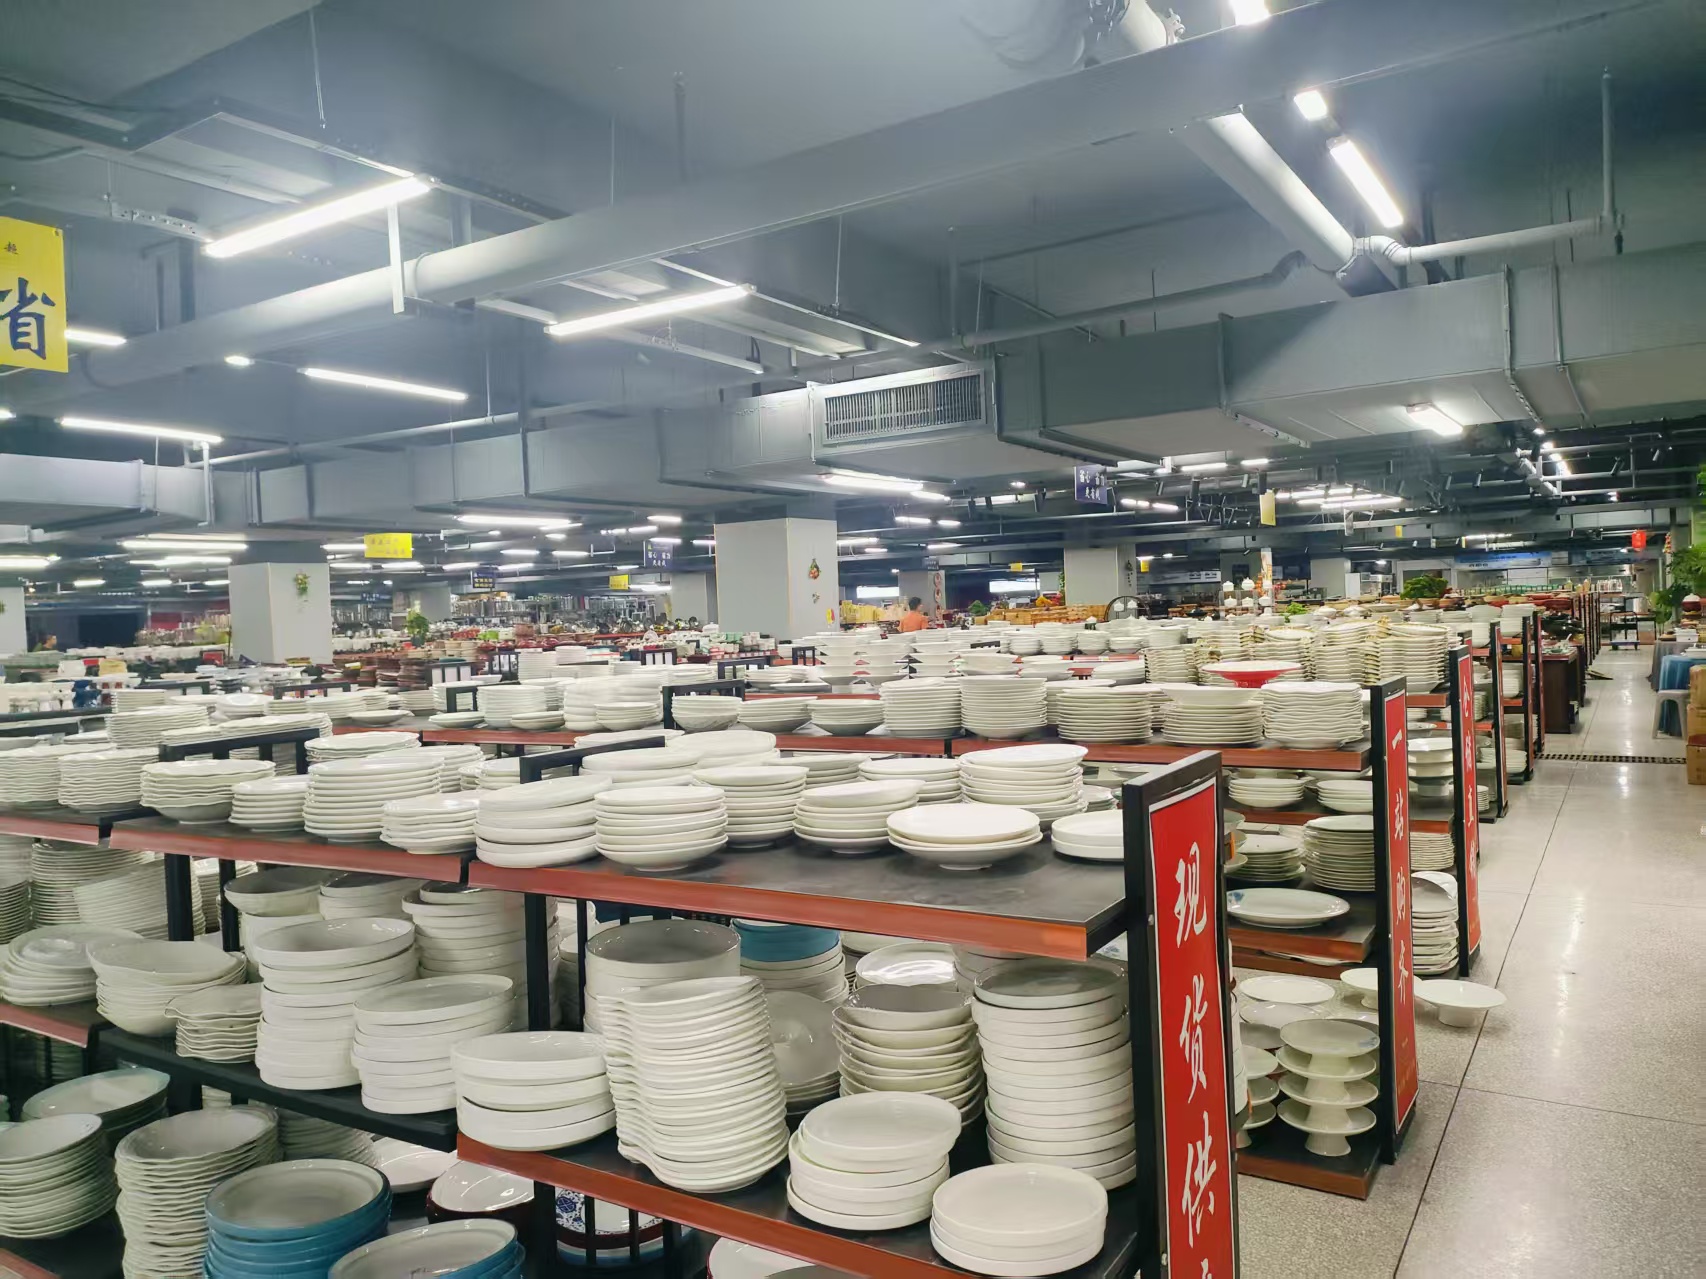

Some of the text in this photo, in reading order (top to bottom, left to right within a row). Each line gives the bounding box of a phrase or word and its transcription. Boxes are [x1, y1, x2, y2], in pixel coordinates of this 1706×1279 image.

[0, 277, 56, 360] 省
[1391, 728, 1409, 1005] 一站购齐
[1173, 841, 1217, 1279] 现货供
